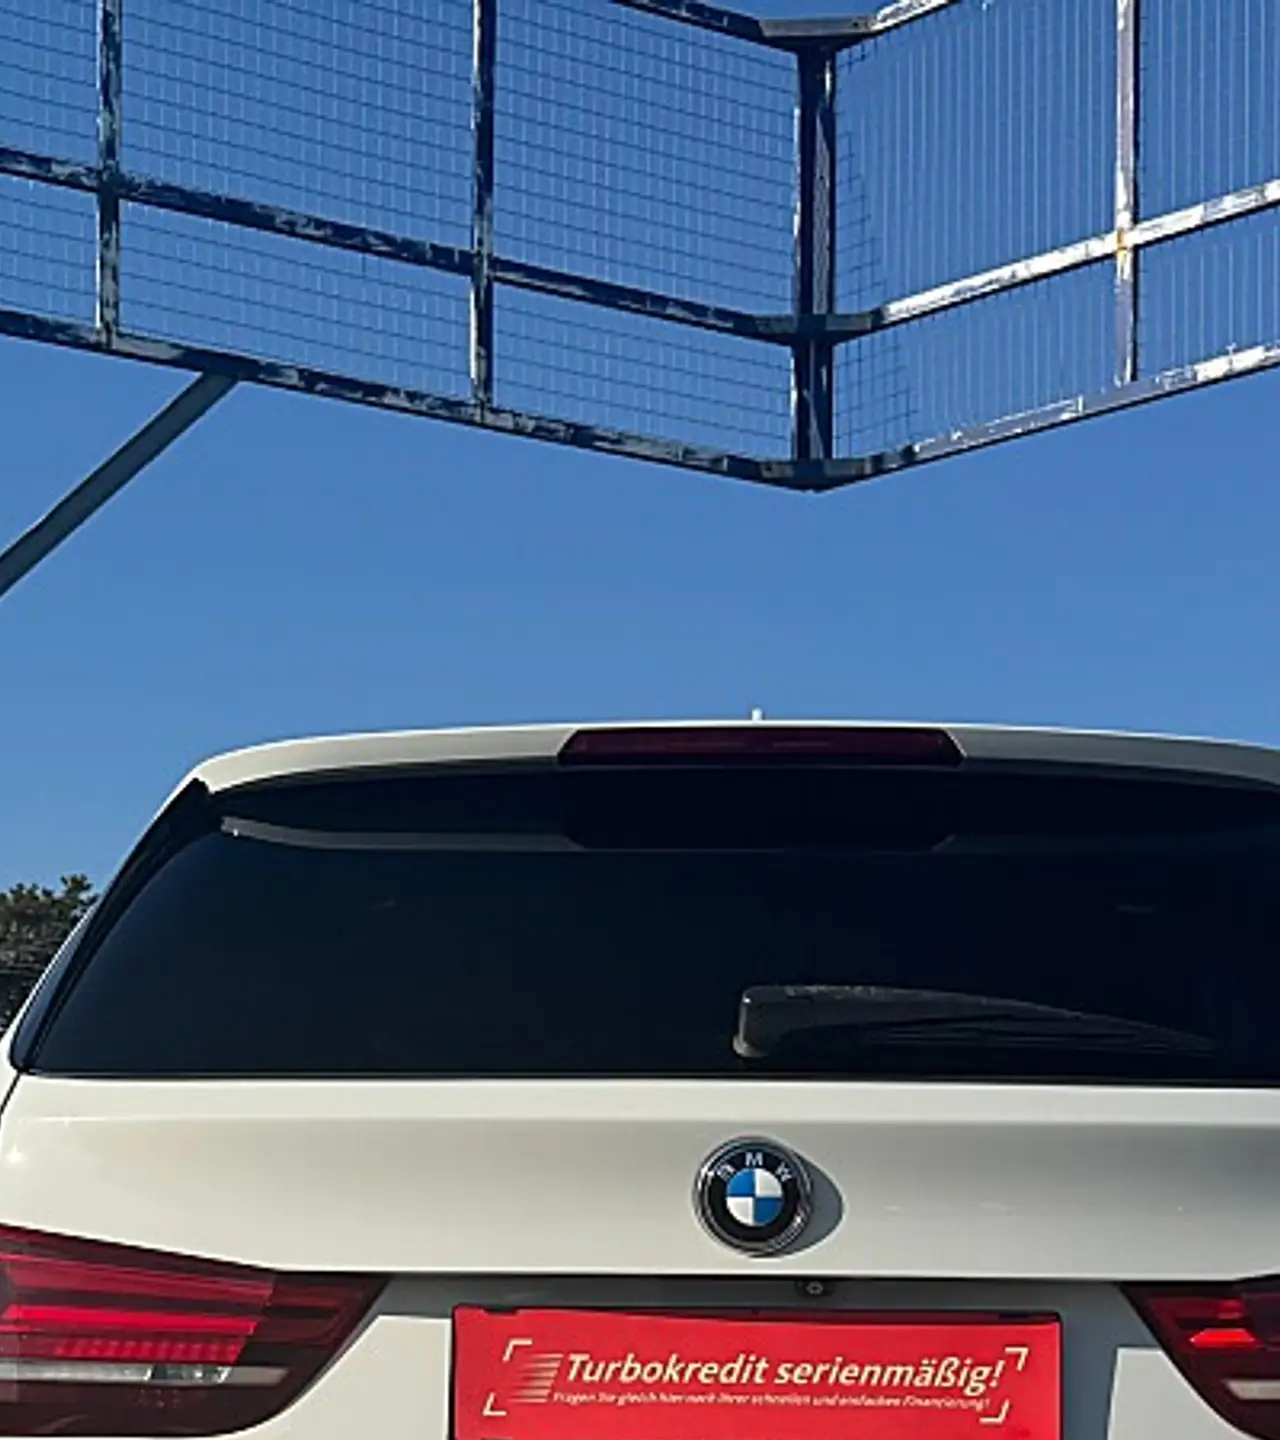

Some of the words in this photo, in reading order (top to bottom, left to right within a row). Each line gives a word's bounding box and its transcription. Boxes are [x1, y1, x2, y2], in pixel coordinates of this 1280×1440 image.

[713, 1151, 793, 1183] BMW
[567, 1352, 770, 1385] Turbokredit
[774, 1356, 1006, 1397] serienmäßig!
